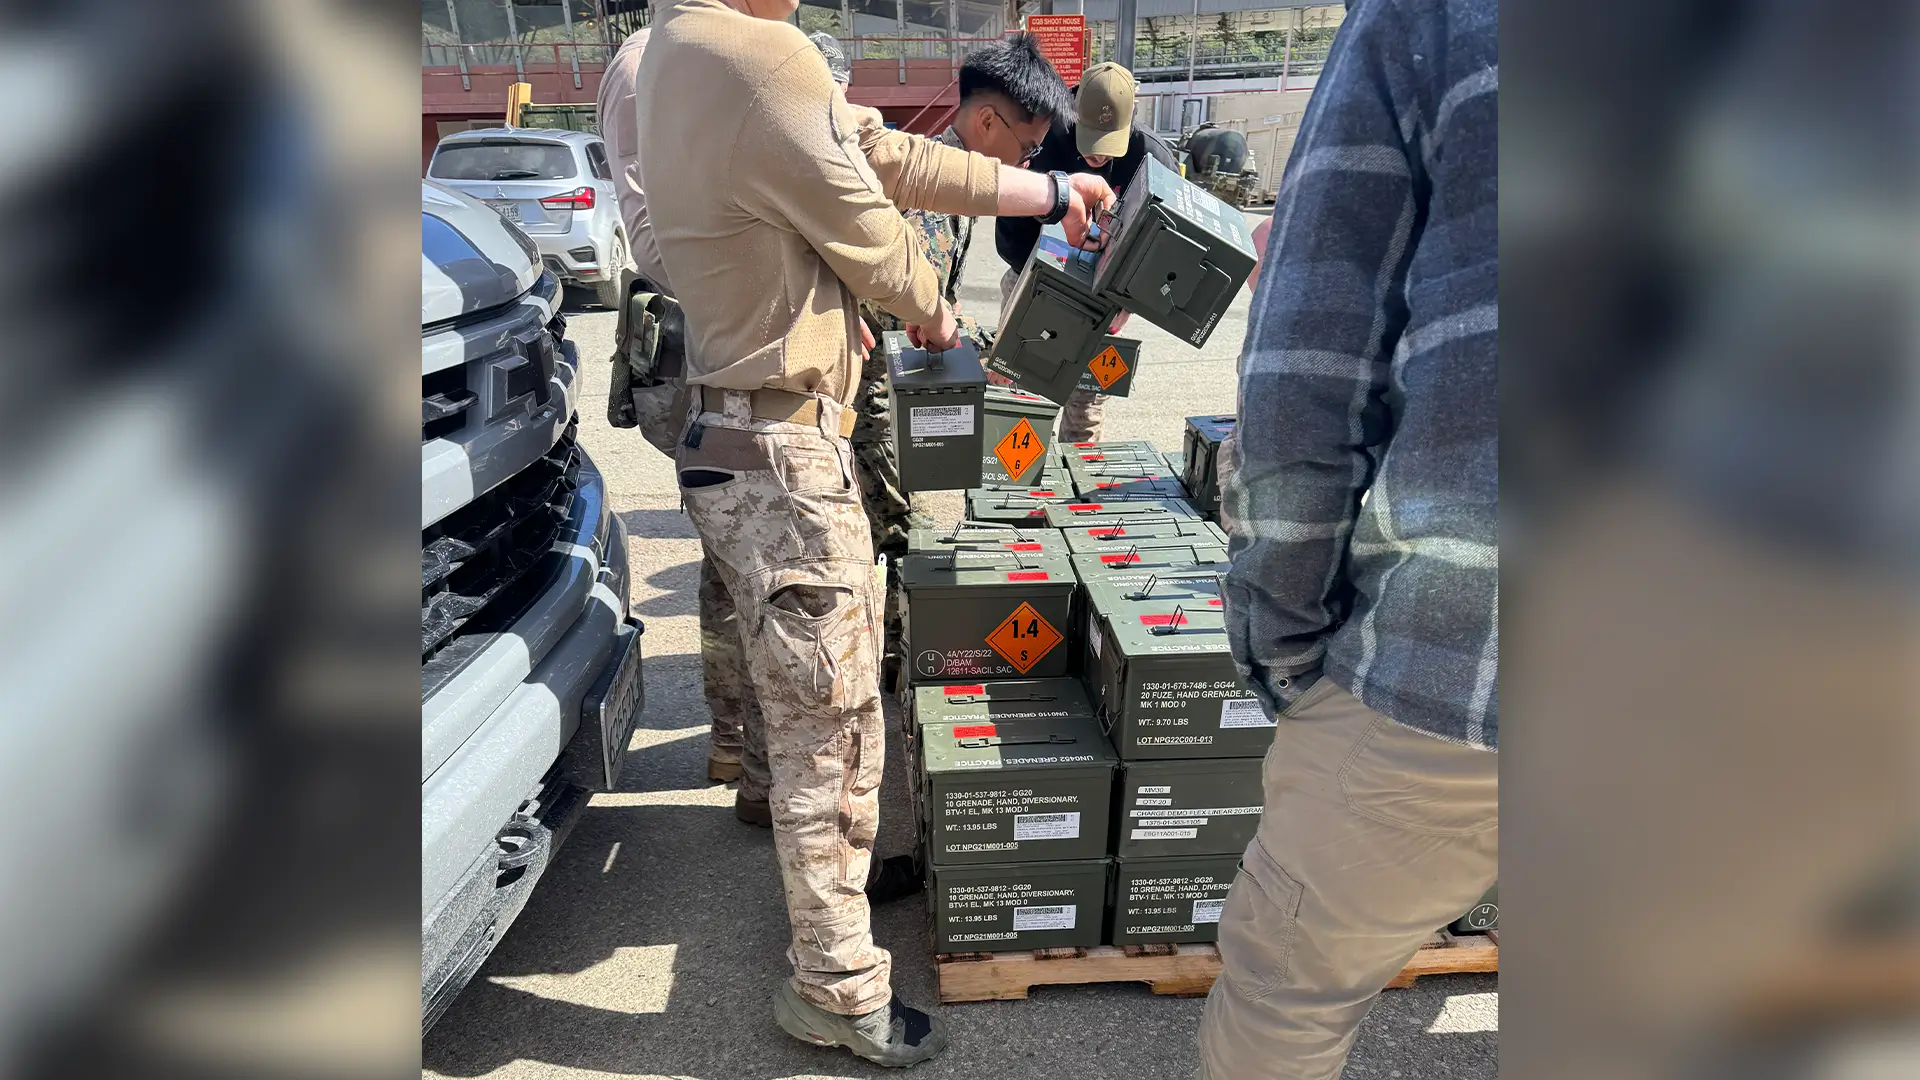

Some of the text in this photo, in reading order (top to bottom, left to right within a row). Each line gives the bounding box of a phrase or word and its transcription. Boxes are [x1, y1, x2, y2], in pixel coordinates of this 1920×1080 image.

[1102, 355, 1117, 368] 1.4
[1012, 432, 1030, 449] 1.4
[1015, 460, 1020, 470] G
[1011, 619, 1039, 638] 1.4
[1020, 650, 1028, 661] S
[947, 666, 994, 675] 12611-SACIL
[1142, 682, 1207, 690] 1330-01-678-7486
[1202, 690, 1243, 698] GRENADE,
[1003, 757, 1058, 765] GRENADES,
[945, 791, 1006, 799] 1330-01-537-9812
[949, 886, 1007, 894] 1330-01-537-9812
